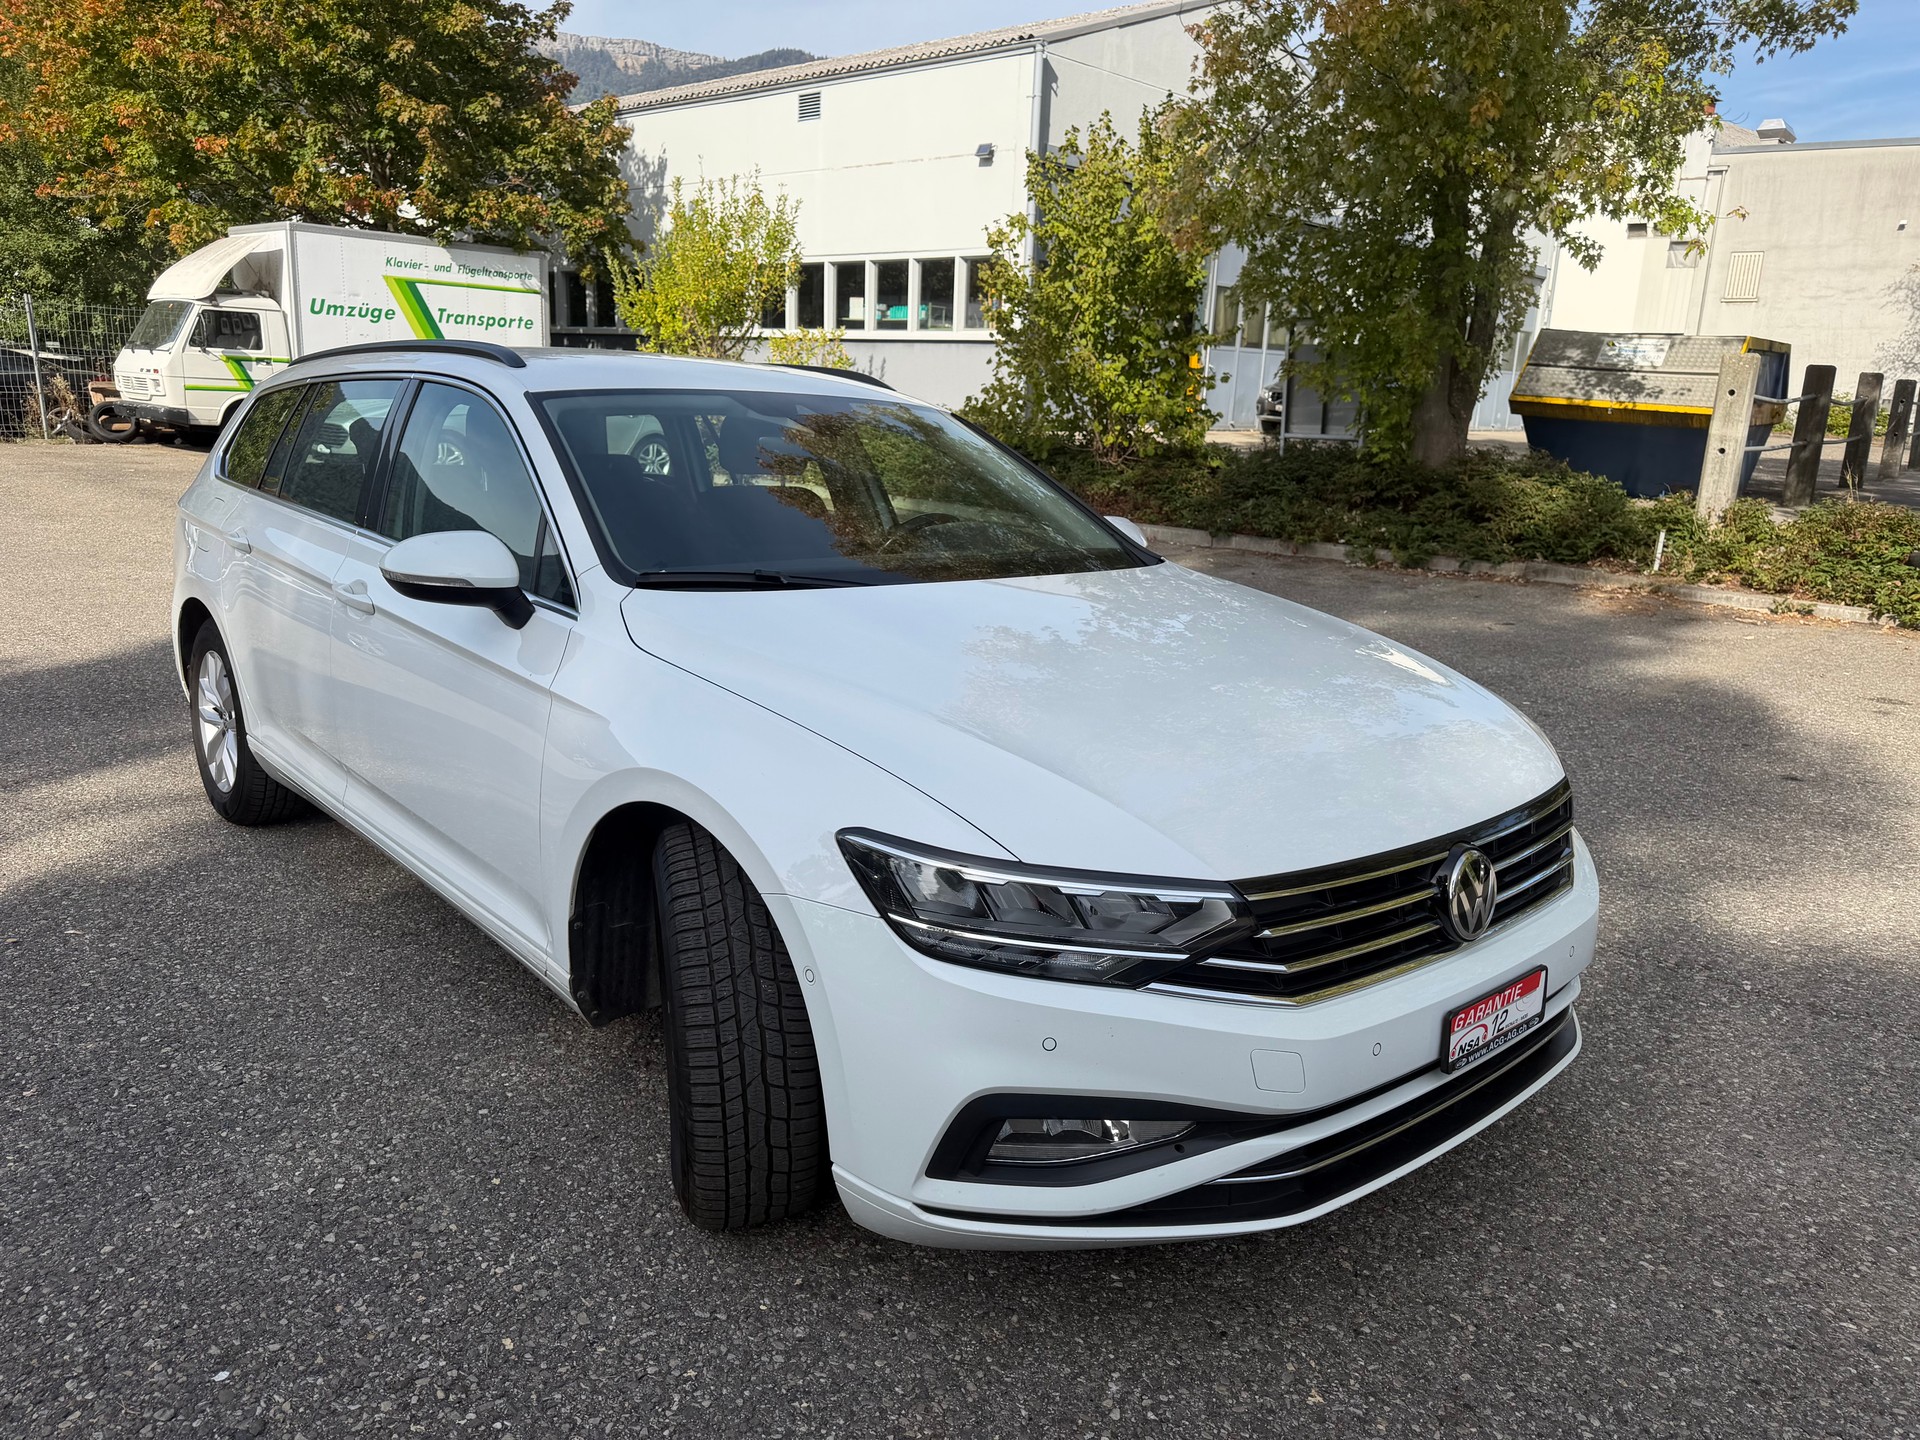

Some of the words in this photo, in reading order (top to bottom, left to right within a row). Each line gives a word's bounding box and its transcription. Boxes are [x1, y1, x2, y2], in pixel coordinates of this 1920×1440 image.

[385, 256, 430, 272] Klavier-
[434, 263, 452, 273] und
[457, 264, 534, 282] Flügeltransporte
[309, 297, 396, 324] Umzüge
[437, 308, 534, 331] Transporte
[1454, 983, 1523, 1032] GARANTIE
[1491, 1008, 1509, 1037] 12
[1457, 1036, 1480, 1057] NSA
[1468, 1024, 1528, 1063] www.ACG-AG.ch
